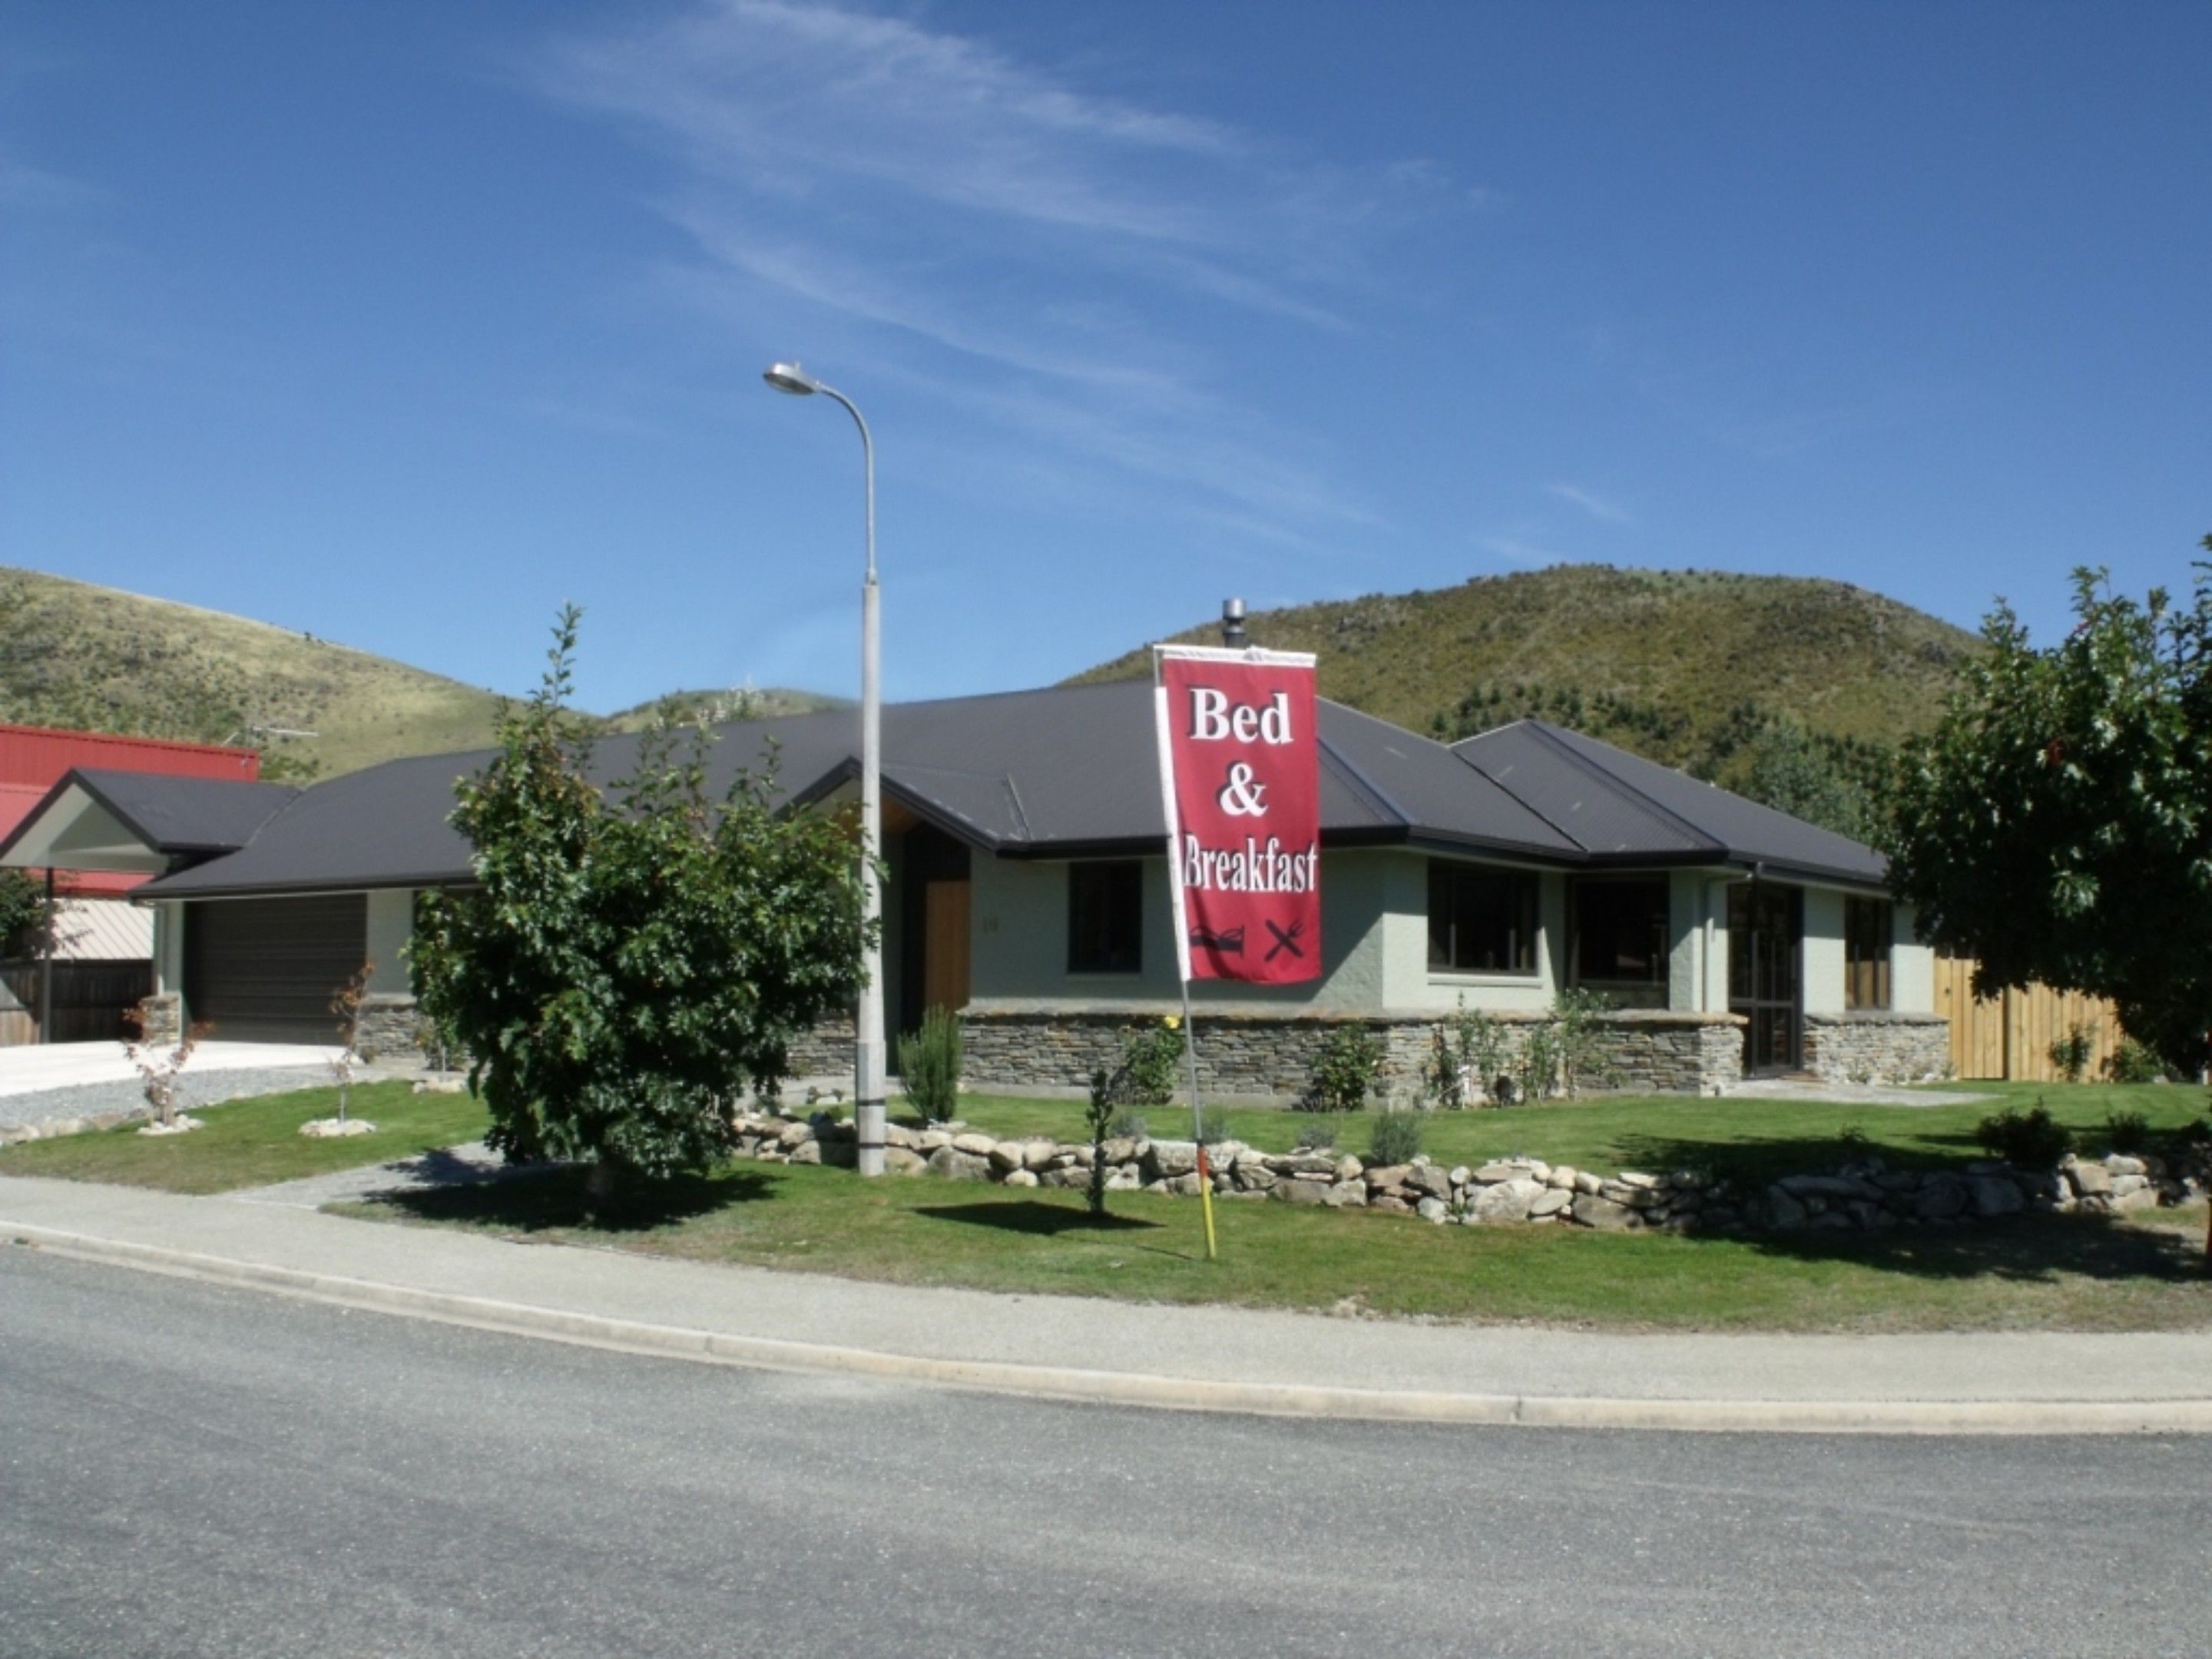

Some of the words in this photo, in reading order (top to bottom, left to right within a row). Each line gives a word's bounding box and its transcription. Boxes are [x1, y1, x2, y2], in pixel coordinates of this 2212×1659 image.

[1189, 687, 1294, 744] Bed
[1219, 762, 1268, 816] &
[1183, 833, 1318, 893] Breakfast
